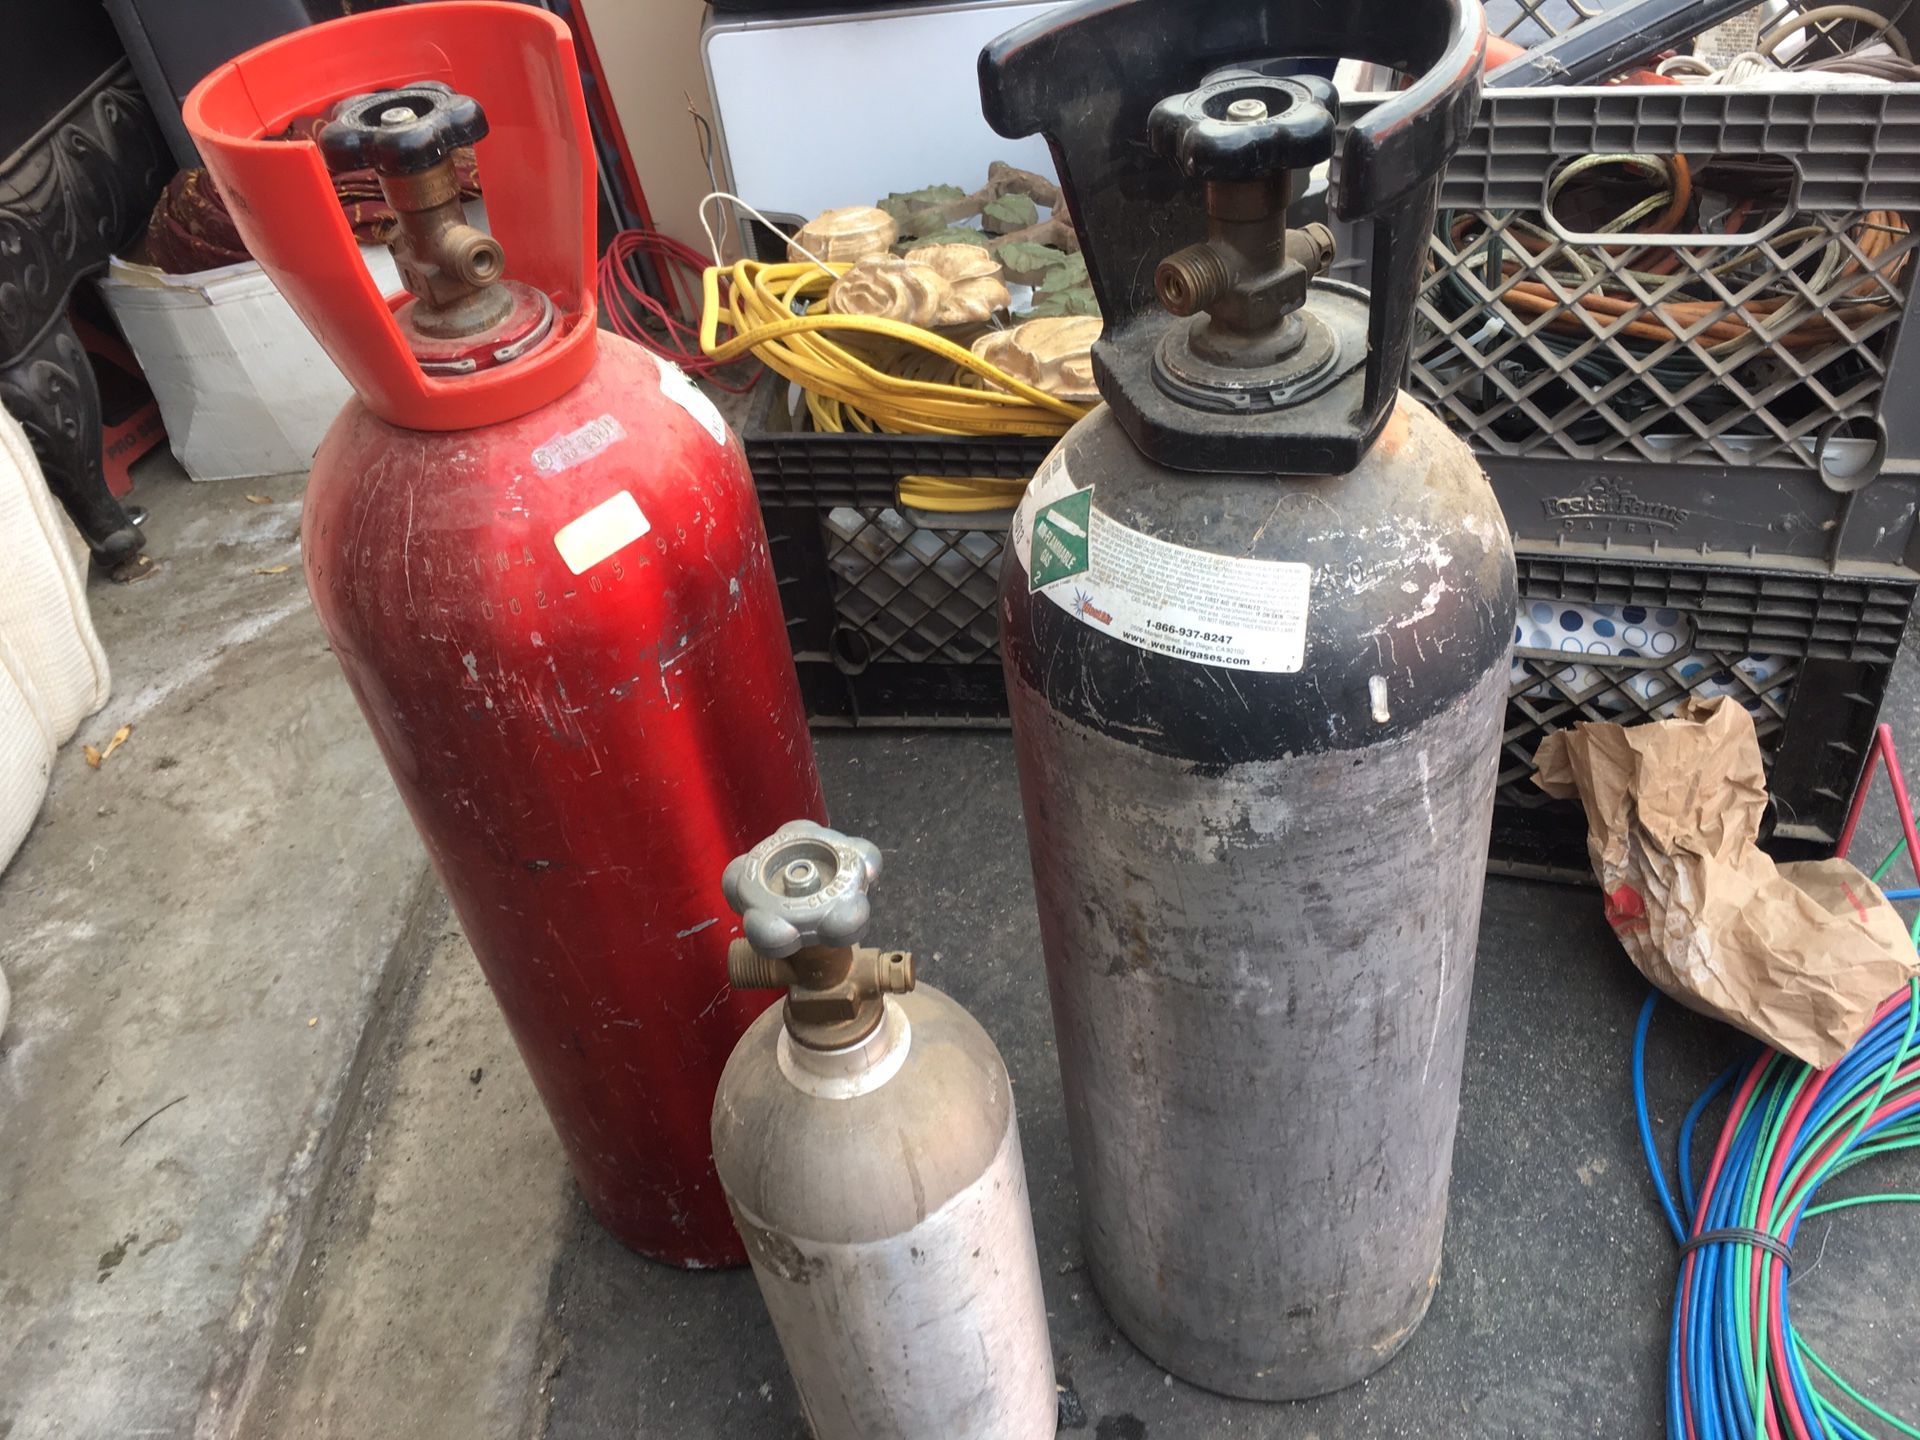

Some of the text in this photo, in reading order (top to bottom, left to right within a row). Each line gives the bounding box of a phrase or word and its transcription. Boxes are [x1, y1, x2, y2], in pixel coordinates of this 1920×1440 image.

[1040, 548, 1053, 568] GAS
[1033, 570, 1042, 585] 2
[1145, 619, 1233, 645] 1-866-937-8247
[1182, 638, 1195, 647] San
[1215, 645, 1226, 653] CA
[1225, 647, 1245, 656] 92102
